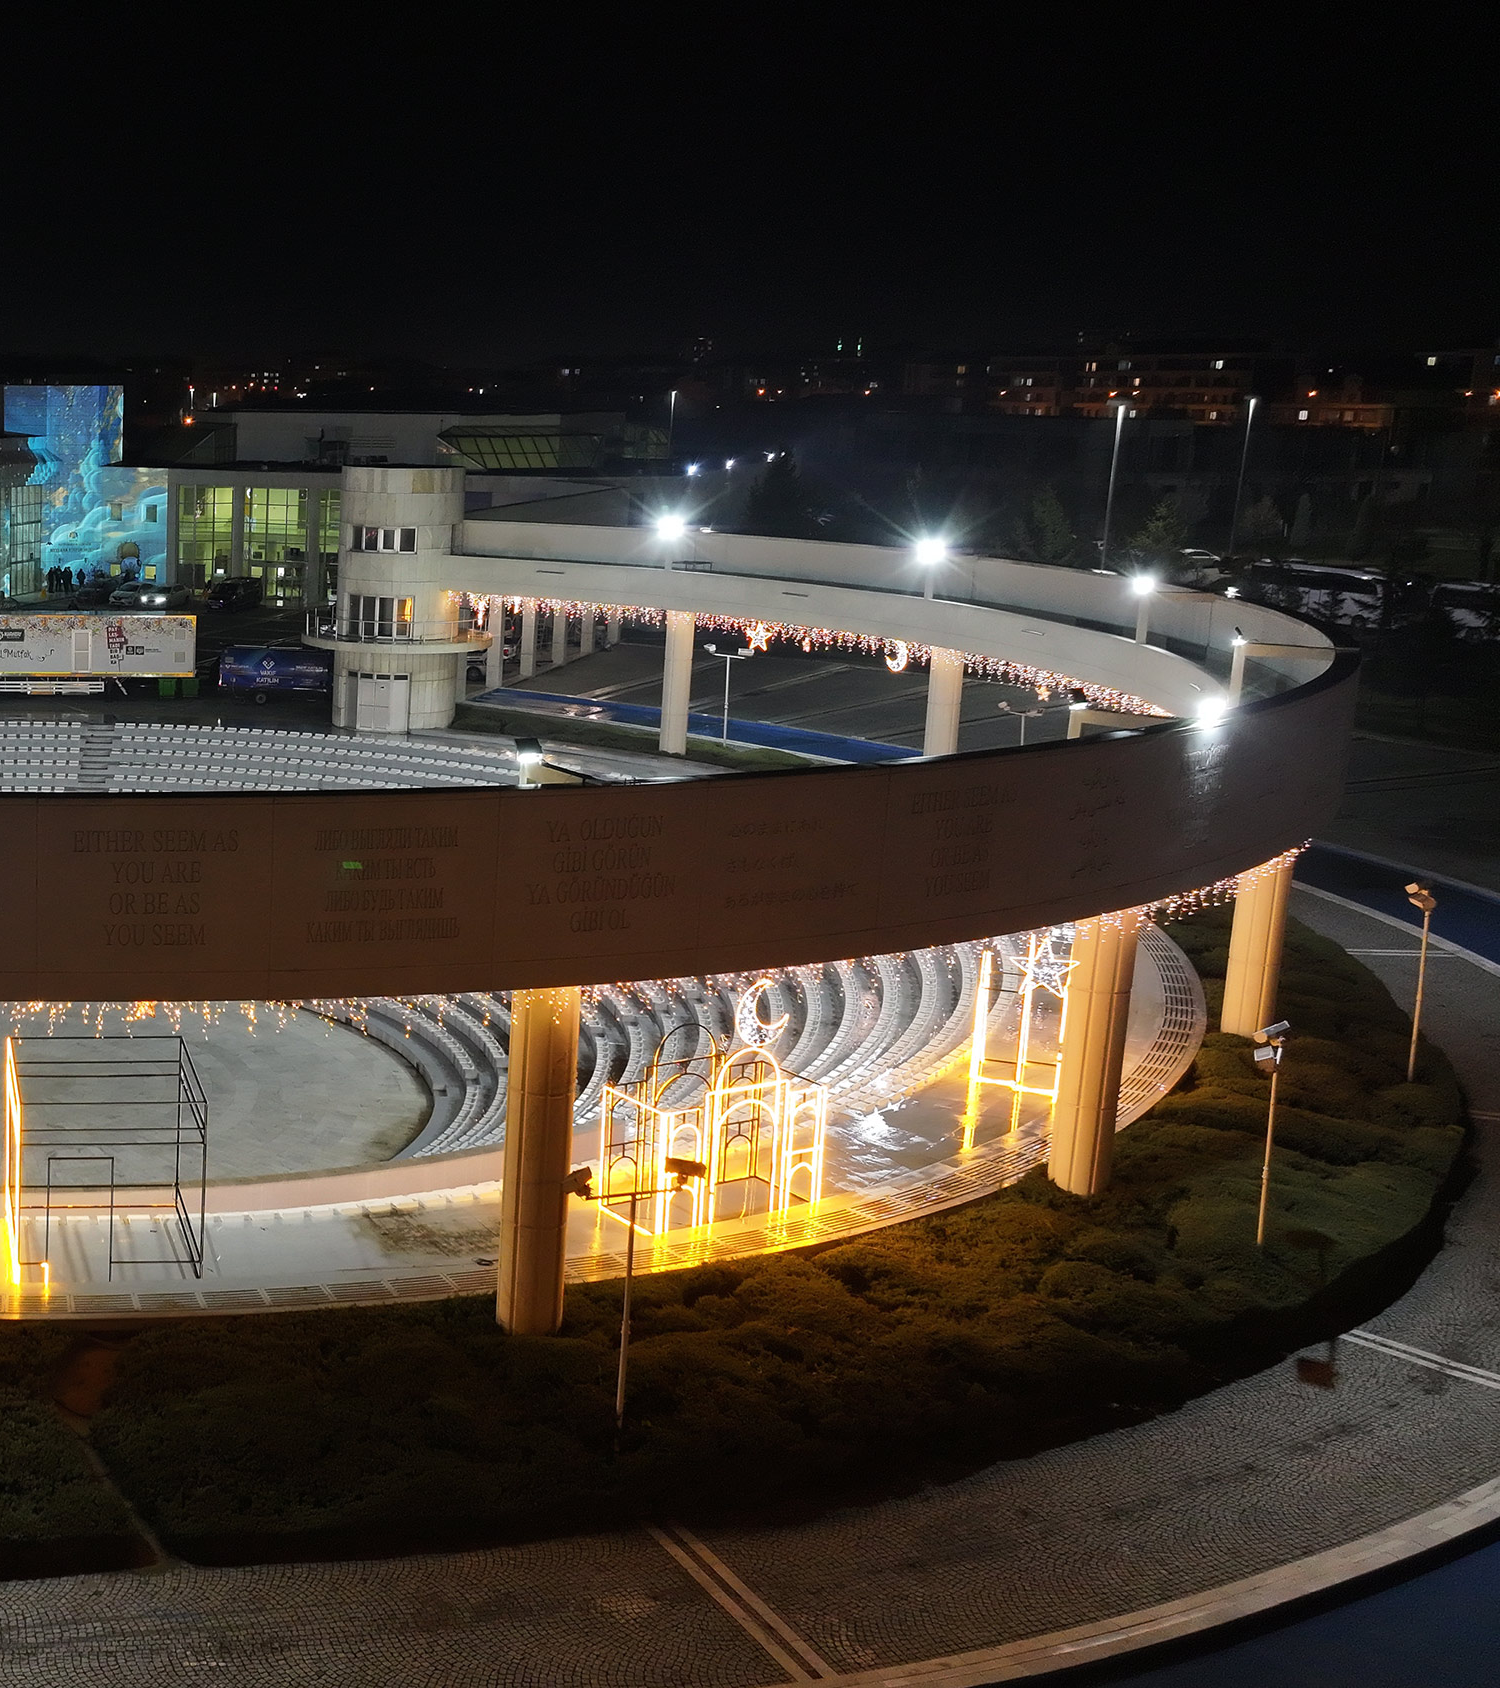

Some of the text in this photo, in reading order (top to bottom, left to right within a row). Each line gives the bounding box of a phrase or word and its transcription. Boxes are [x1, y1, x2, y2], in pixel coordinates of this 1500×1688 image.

[314, 825, 459, 851] ЛИБО ВЫГЛЯДИ ТАКИМ
[546, 813, 664, 843] YA OLDUĞUN
[73, 829, 239, 853] EITHER SEEM AS
[383, 858, 402, 880] ТЫ
[405, 857, 436, 879] ЕСТЬ
[553, 842, 652, 874] GİBİ GÖRÜN
[110, 861, 202, 884] YOU ARE
[324, 889, 360, 912] ЛИБО
[399, 887, 444, 910] ТАКИМ
[526, 872, 676, 906] YA GÖRÜNDÜĞÜN
[109, 892, 200, 915] OR BE AS
[306, 917, 460, 943] КАКИМ ТЫ ВЫГЛЯДИШЬ
[569, 906, 631, 933] GİBİ OL
[102, 923, 207, 946] YOU SEEM
